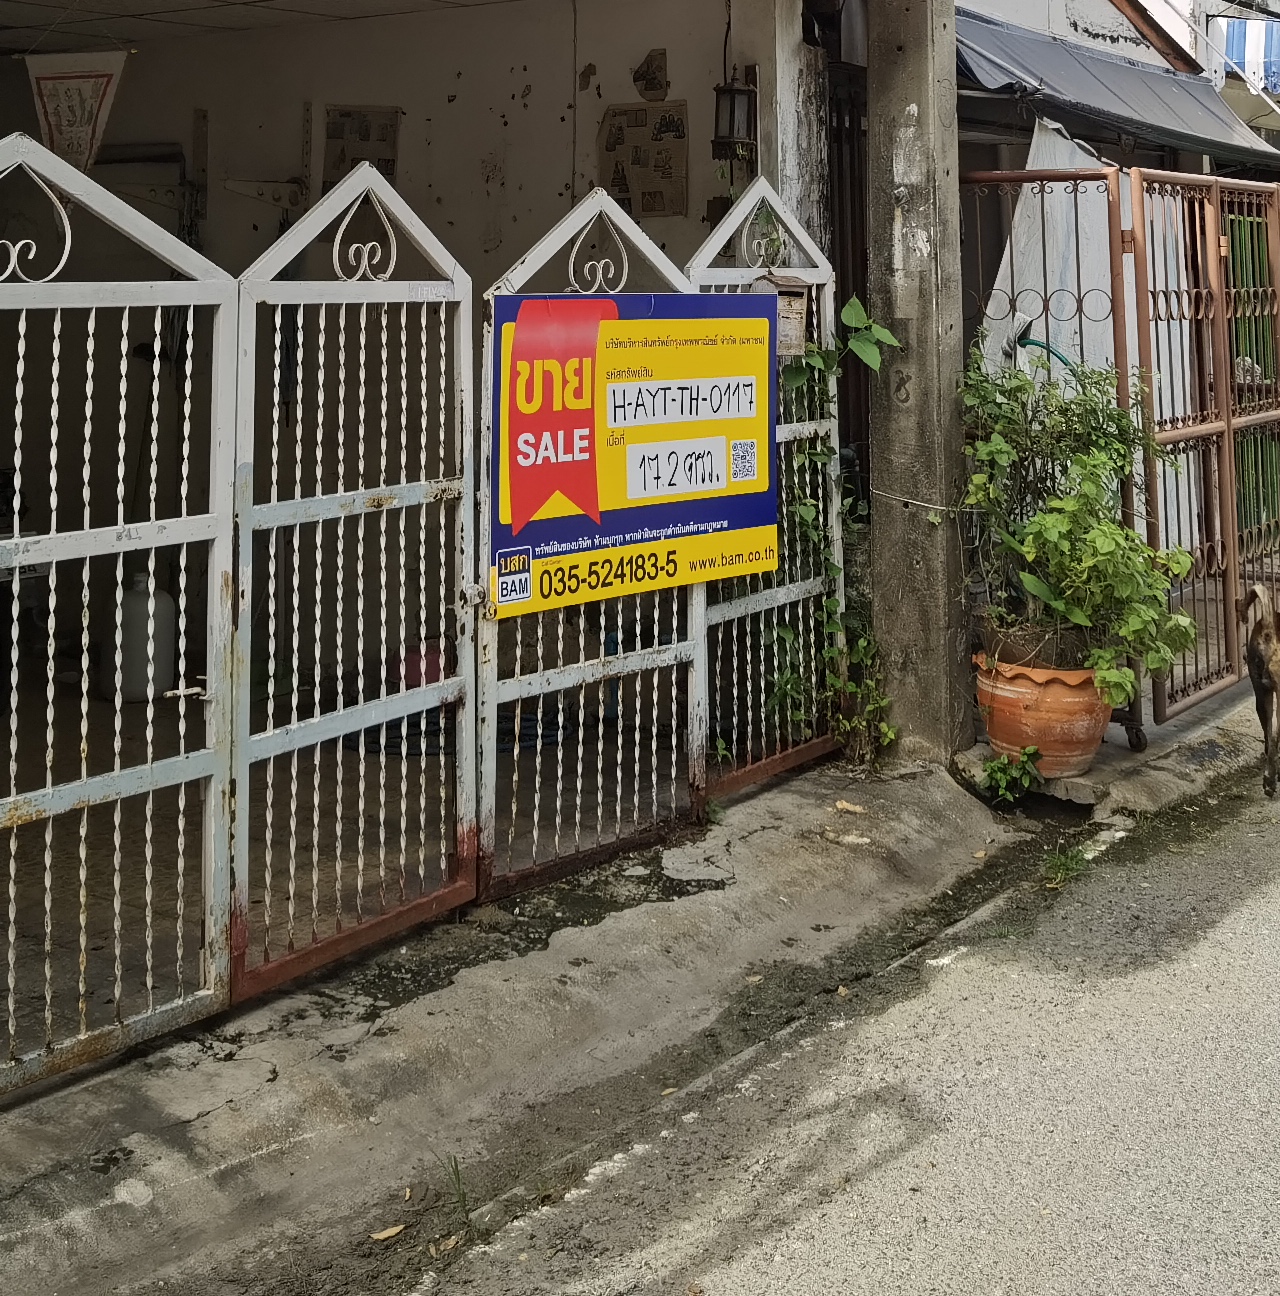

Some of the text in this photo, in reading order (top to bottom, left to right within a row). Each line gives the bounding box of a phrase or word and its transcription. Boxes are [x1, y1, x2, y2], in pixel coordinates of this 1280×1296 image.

[516, 357, 592, 415] ขาย
[613, 382, 754, 423] H-AYT-TH-0117
[516, 428, 590, 467] SALE
[606, 431, 625, 447] เนื้อที่
[500, 554, 528, 573] บสก
[539, 545, 775, 600] 035-524183-5 www.bam.co.th
[500, 577, 528, 598] BAM
